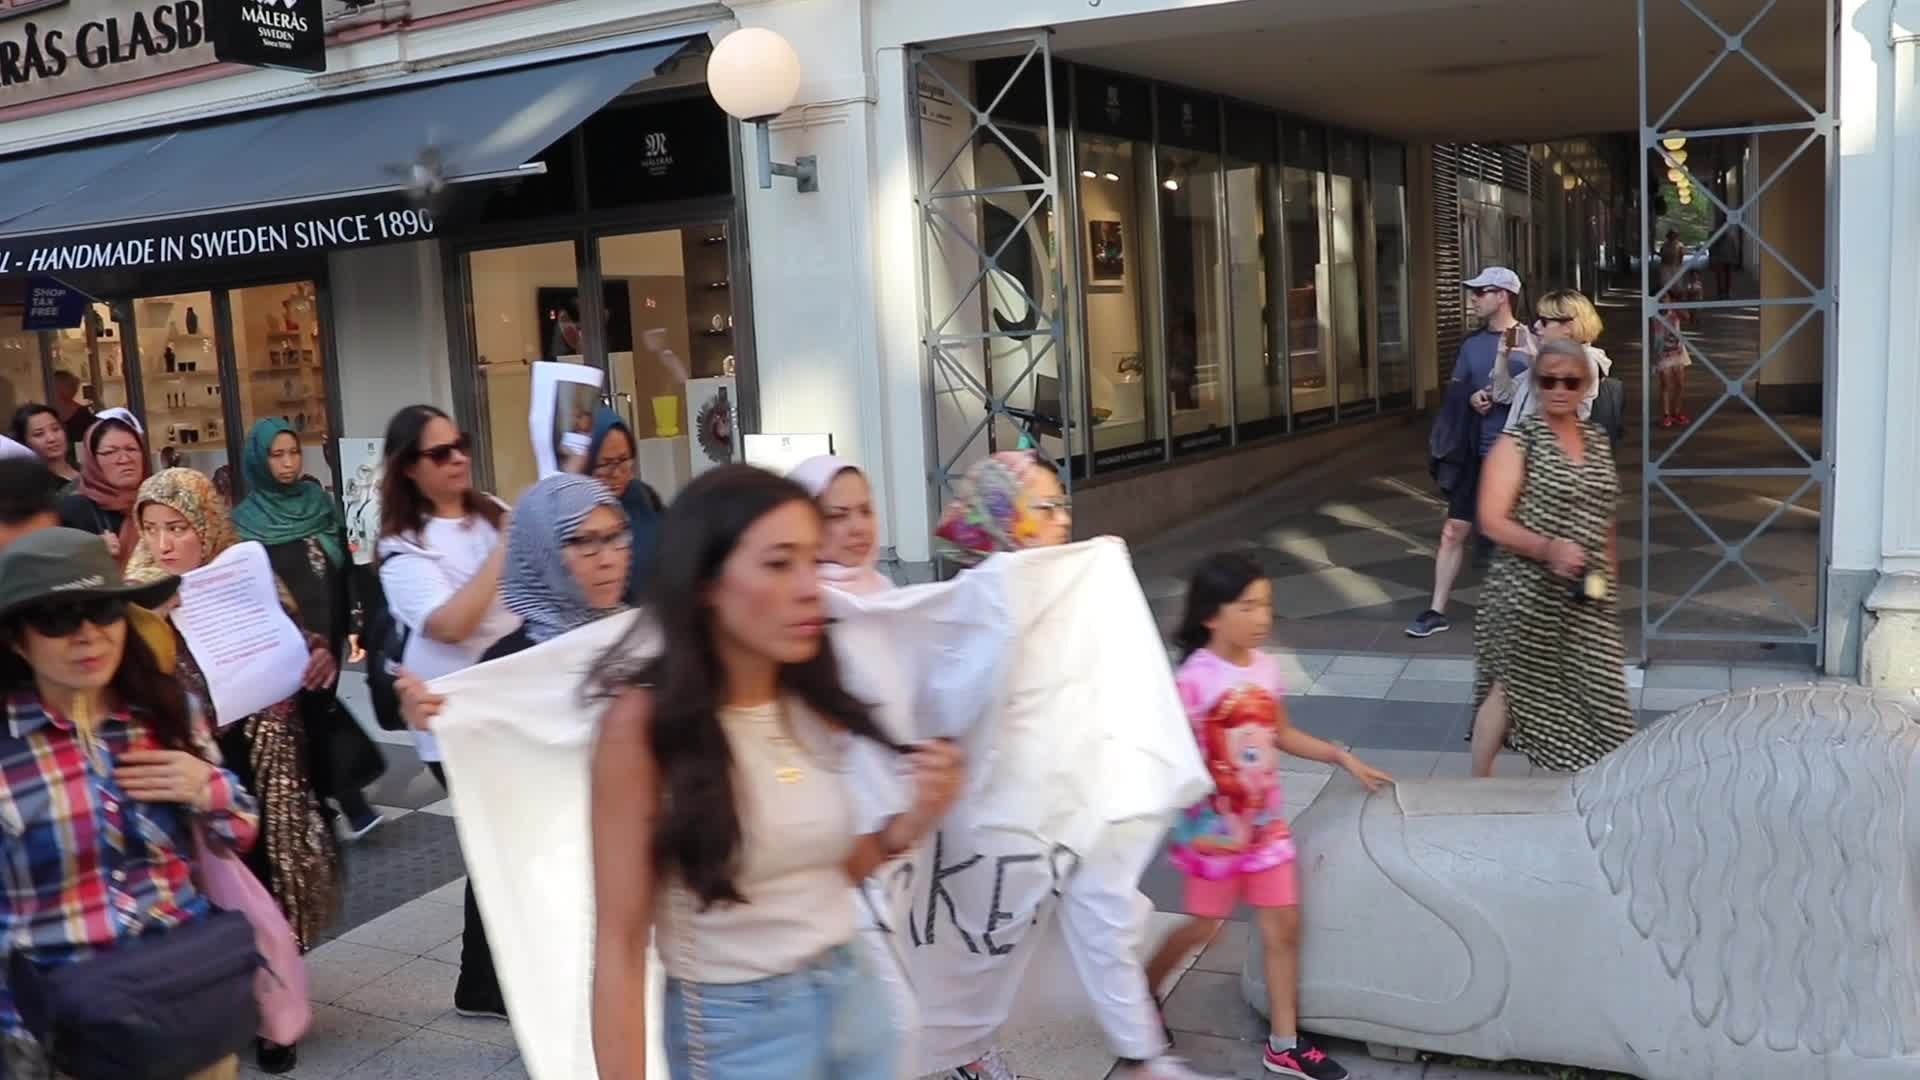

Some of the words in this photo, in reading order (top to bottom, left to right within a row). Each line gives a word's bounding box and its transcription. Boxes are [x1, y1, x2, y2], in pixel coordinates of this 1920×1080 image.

[241, 5, 308, 32] MÅLERÅS
[0, 22, 66, 86] RÅS
[76, 0, 209, 69] GLASB
[257, 26, 295, 41] SWEDEN
[0, 251, 10, 273] L
[27, 238, 155, 272] HANDMADE
[160, 235, 185, 263] IN
[189, 224, 288, 260] SWEDEN
[294, 214, 370, 249] SINCE
[373, 208, 434, 239] 1890
[32, 287, 66, 297] SHOP
[31, 307, 57, 316] FREE
